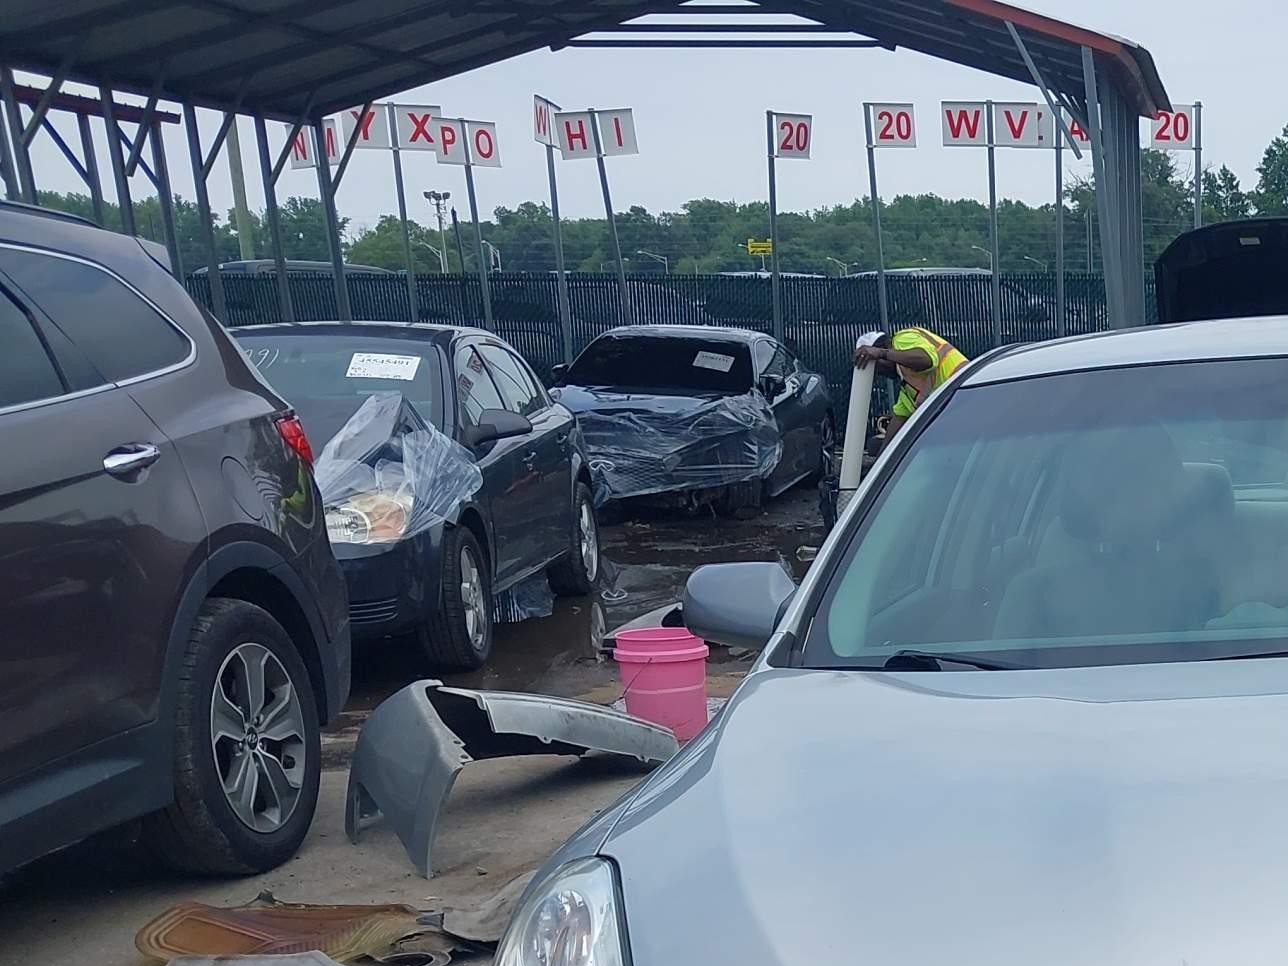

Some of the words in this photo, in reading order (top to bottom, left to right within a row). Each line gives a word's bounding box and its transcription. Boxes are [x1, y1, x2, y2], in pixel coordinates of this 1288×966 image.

[351, 111, 376, 141] Y
[407, 112, 434, 143] X
[536, 103, 547, 136] W
[565, 120, 588, 151] H
[614, 117, 623, 147] I
[877, 111, 912, 140] 20
[945, 109, 981, 139] W
[1004, 110, 1029, 139] V
[1154, 111, 1190, 142] 20
[440, 126, 456, 155] P
[475, 129, 493, 159] O
[780, 121, 809, 151] 20
